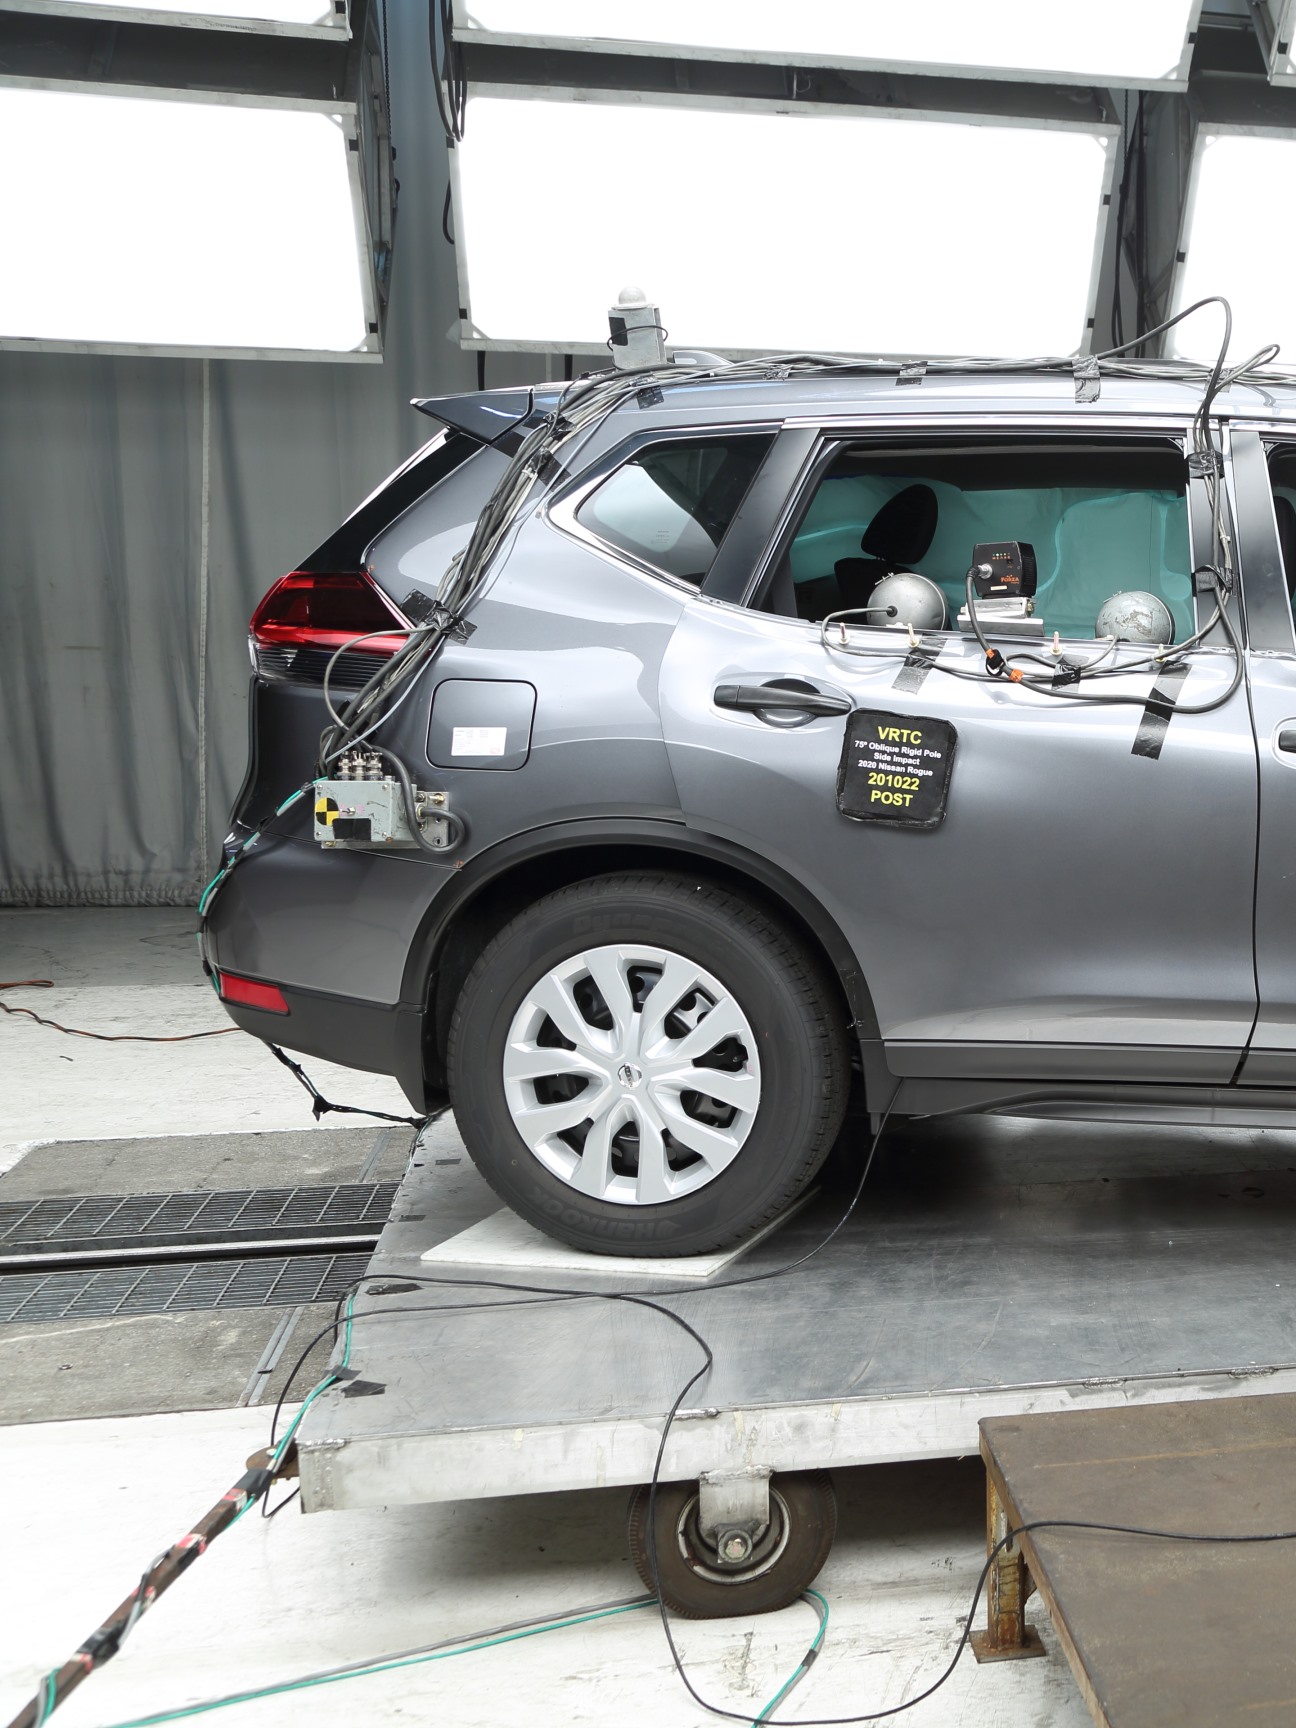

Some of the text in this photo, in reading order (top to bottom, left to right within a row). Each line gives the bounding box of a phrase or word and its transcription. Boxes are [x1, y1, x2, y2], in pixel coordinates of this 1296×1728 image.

[877, 725, 922, 745] VRTC
[868, 741, 900, 753] Oblique
[901, 746, 922, 757] Rigid
[924, 749, 942, 759] Pole
[873, 752, 920, 765] Side Impact
[858, 759, 934, 777] 2020 Nissan Rogue
[867, 772, 920, 791] 201022
[870, 789, 914, 807] POST
